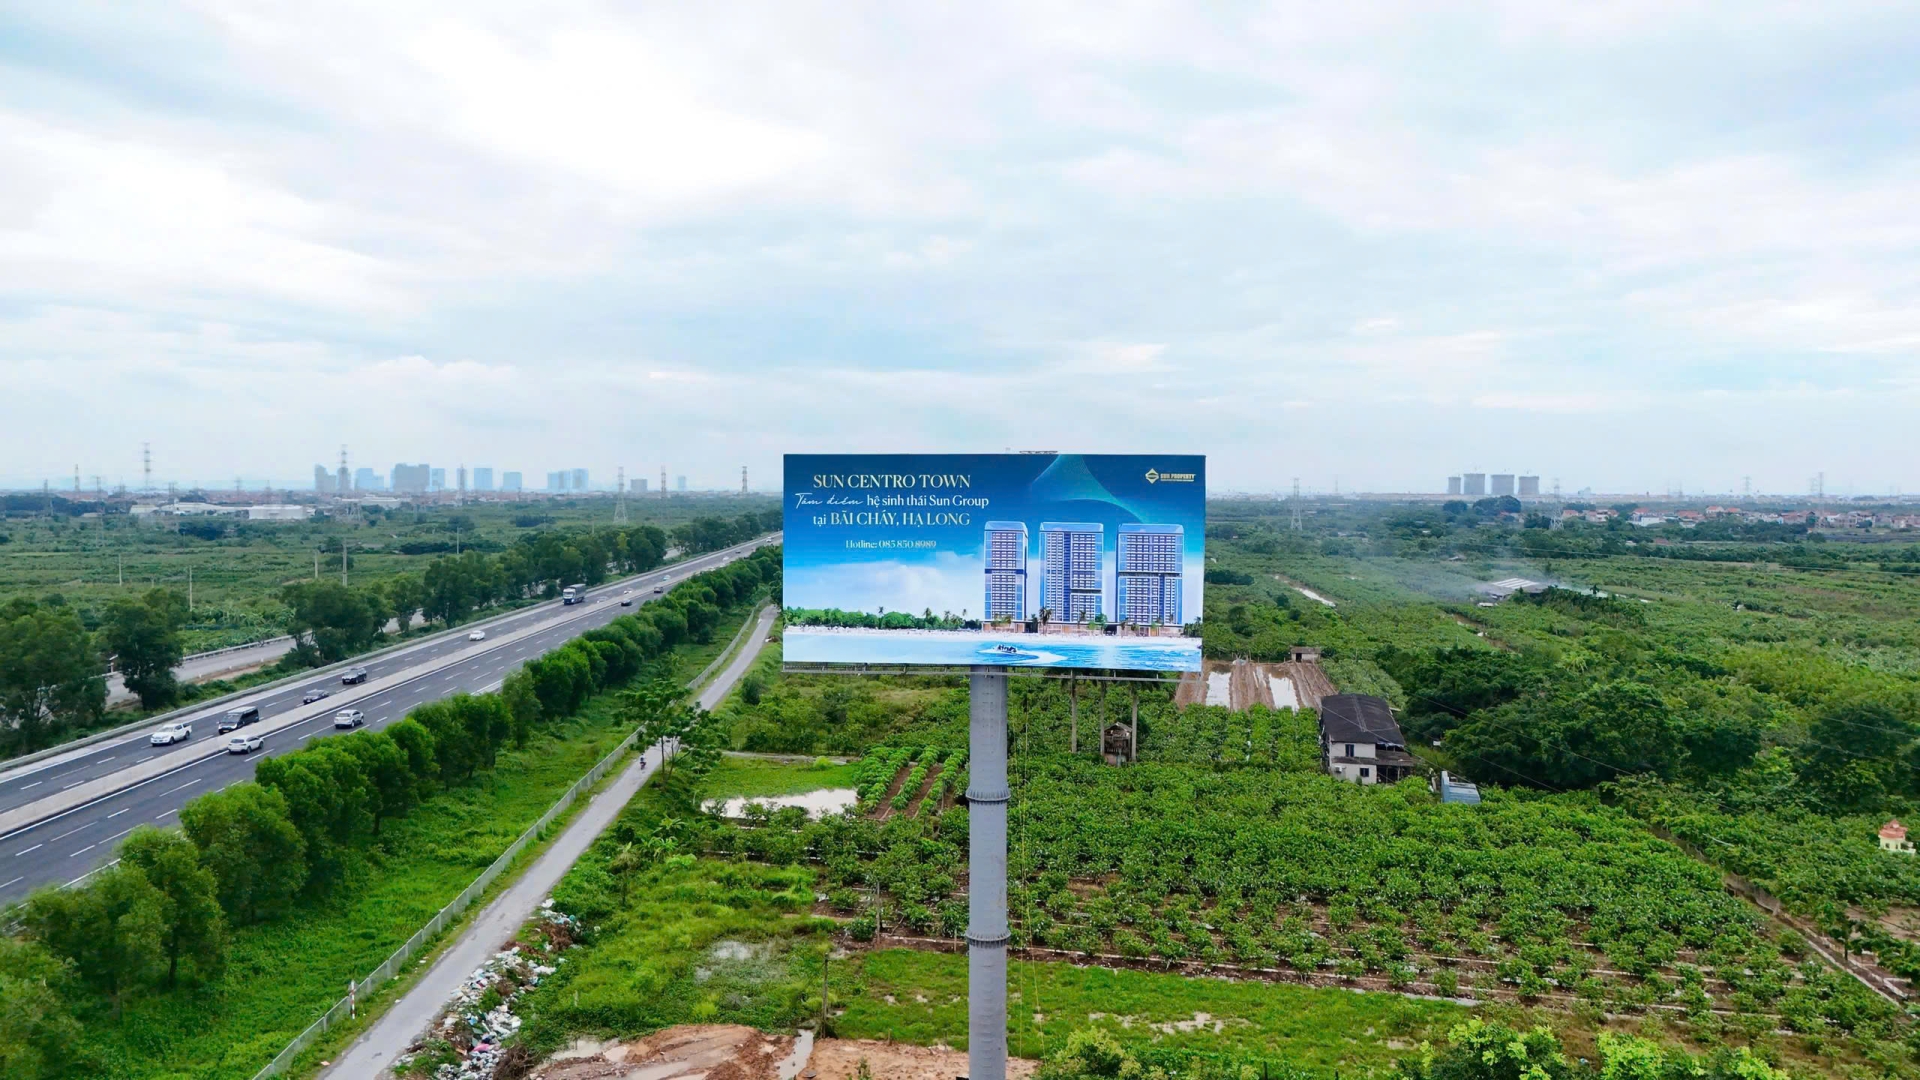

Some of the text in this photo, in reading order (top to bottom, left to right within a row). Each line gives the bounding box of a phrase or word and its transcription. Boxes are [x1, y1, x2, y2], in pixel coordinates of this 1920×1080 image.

[813, 474, 970, 488] SUN CENTRO TOWN
[867, 494, 880, 508] hệ
[882, 494, 904, 506] sinh
[906, 494, 927, 506] thái
[929, 494, 950, 506] Sun
[952, 494, 989, 509] Group
[813, 509, 970, 528] tại BÃI CHÁY, HẠ LONG
[845, 540, 877, 549] Hotline:
[878, 540, 896, 549] 085
[896, 540, 914, 549] 850
